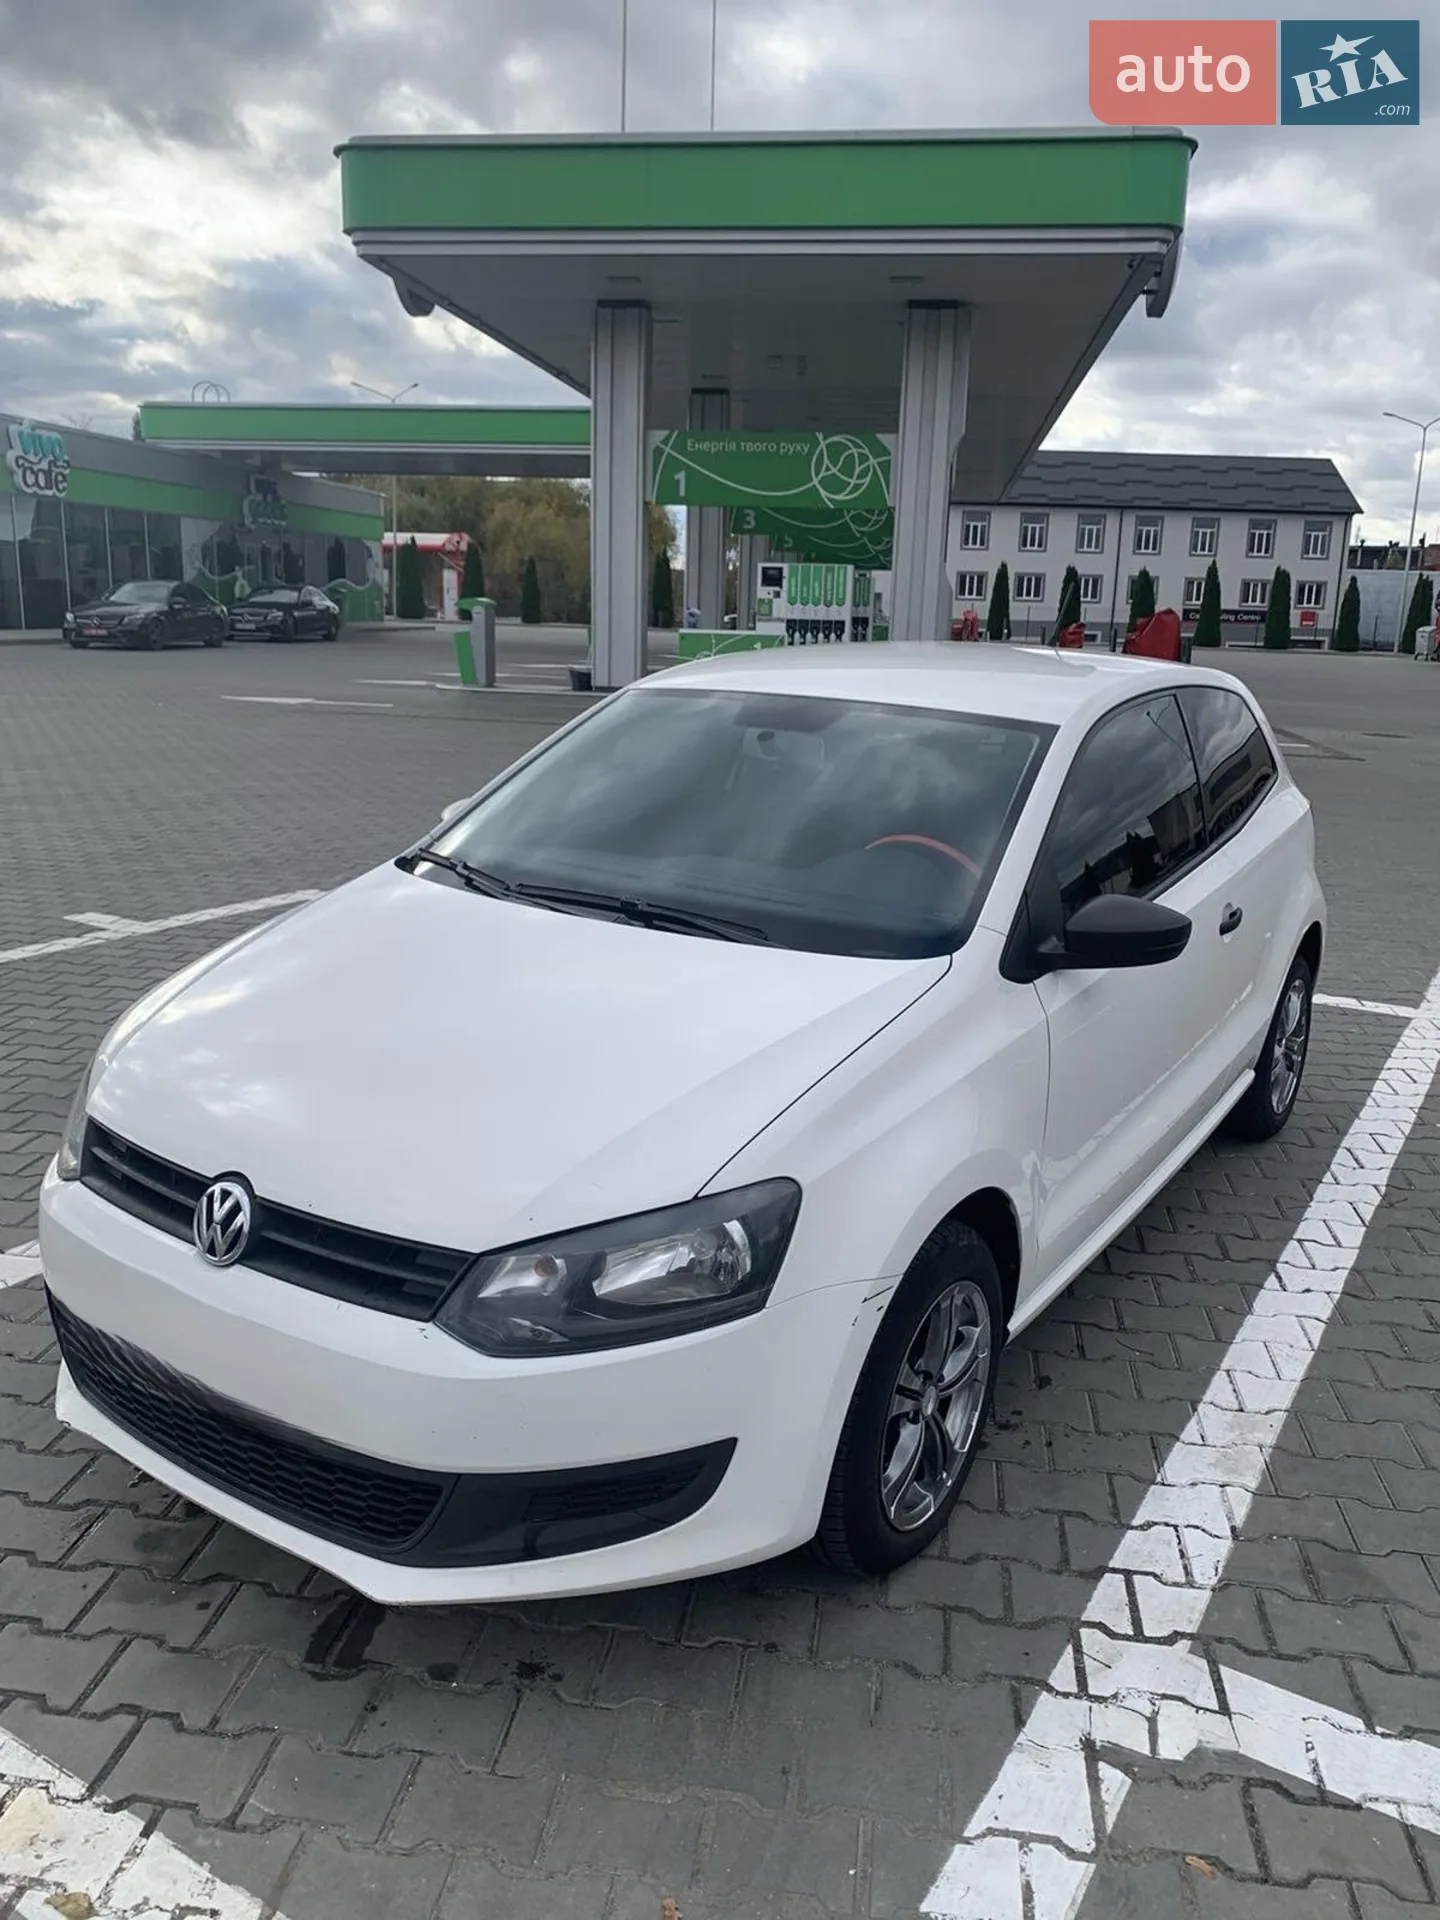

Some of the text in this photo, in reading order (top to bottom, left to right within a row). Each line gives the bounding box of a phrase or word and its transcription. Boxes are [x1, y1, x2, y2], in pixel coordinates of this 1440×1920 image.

[686, 438, 811, 456] Енергія твого руху
[674, 470, 686, 497] 1
[743, 509, 757, 529] 3
